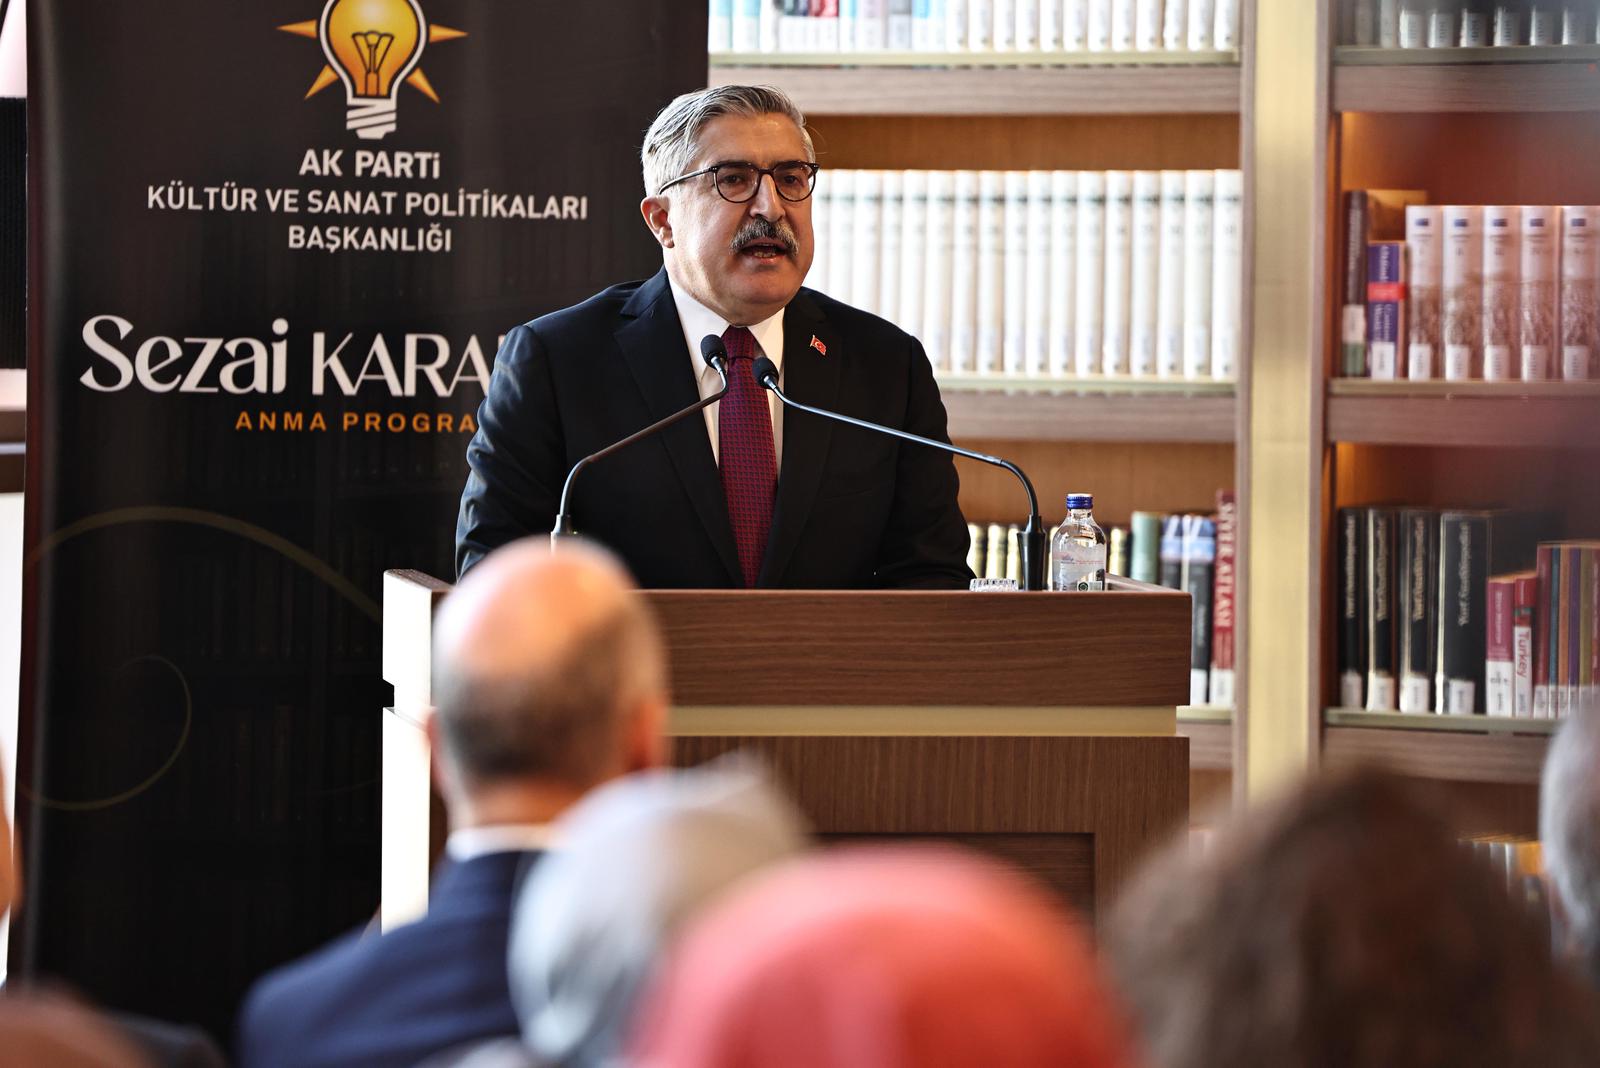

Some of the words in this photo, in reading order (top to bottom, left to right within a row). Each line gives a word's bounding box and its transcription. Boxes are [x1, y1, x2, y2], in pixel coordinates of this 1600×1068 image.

[299, 149, 342, 177] AK
[147, 181, 257, 212] KÜLTÜR
[265, 189, 299, 213] VE
[307, 189, 397, 216] SANAT
[405, 187, 588, 220] POLİTİKALARI
[288, 222, 452, 253] BAŞKANLIĞI
[79, 314, 288, 393] Sezai
[312, 332, 505, 397] KARA
[236, 411, 327, 431] ANMA
[343, 413, 475, 433] PROGRA
[1516, 631, 1530, 679] Turkey
